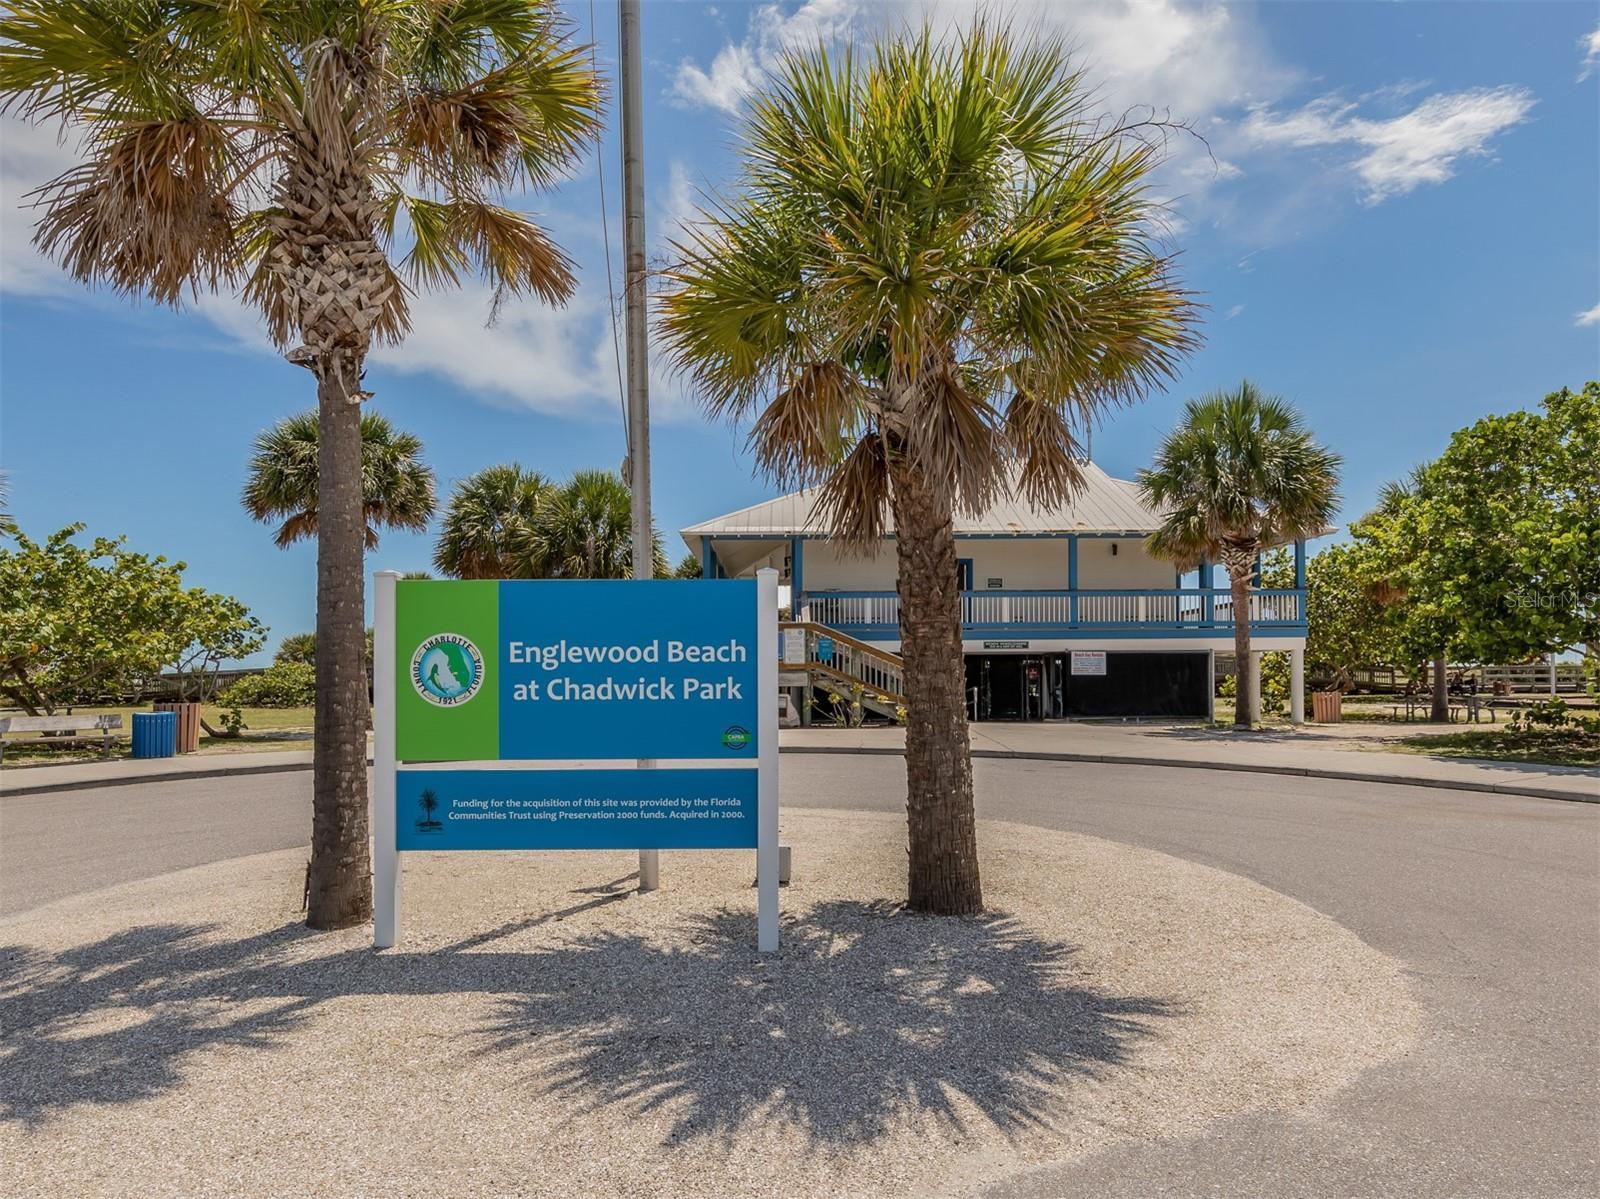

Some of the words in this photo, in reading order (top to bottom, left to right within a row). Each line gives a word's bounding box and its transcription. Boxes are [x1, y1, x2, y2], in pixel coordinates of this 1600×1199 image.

[423, 635, 471, 652] CHARLOTTE
[509, 639, 659, 671] Englewood
[667, 639, 747, 663] Beach
[412, 660, 428, 694] COUNTY
[466, 658, 483, 696] FLORIDA
[513, 680, 540, 701] at
[546, 676, 676, 701] Chadwick
[683, 676, 743, 700] Park
[438, 697, 458, 705] 1921
[453, 799, 488, 809] Funding
[491, 799, 503, 807] for
[506, 799, 520, 807] the
[523, 799, 570, 809] acquisition
[573, 799, 582, 807] of
[585, 799, 600, 807] this
[602, 799, 619, 807] site
[640, 798, 679, 808] provided
[682, 798, 692, 808] by
[694, 798, 708, 806] the
[711, 798, 741, 806] Florida
[449, 811, 507, 819] Communities
[509, 811, 531, 819] Trust
[533, 811, 557, 821] using
[559, 811, 615, 819] Preservation
[617, 811, 638, 819] 2000
[640, 811, 668, 819] funds.
[669, 810, 709, 820] Acquired
[711, 810, 719, 818] in
